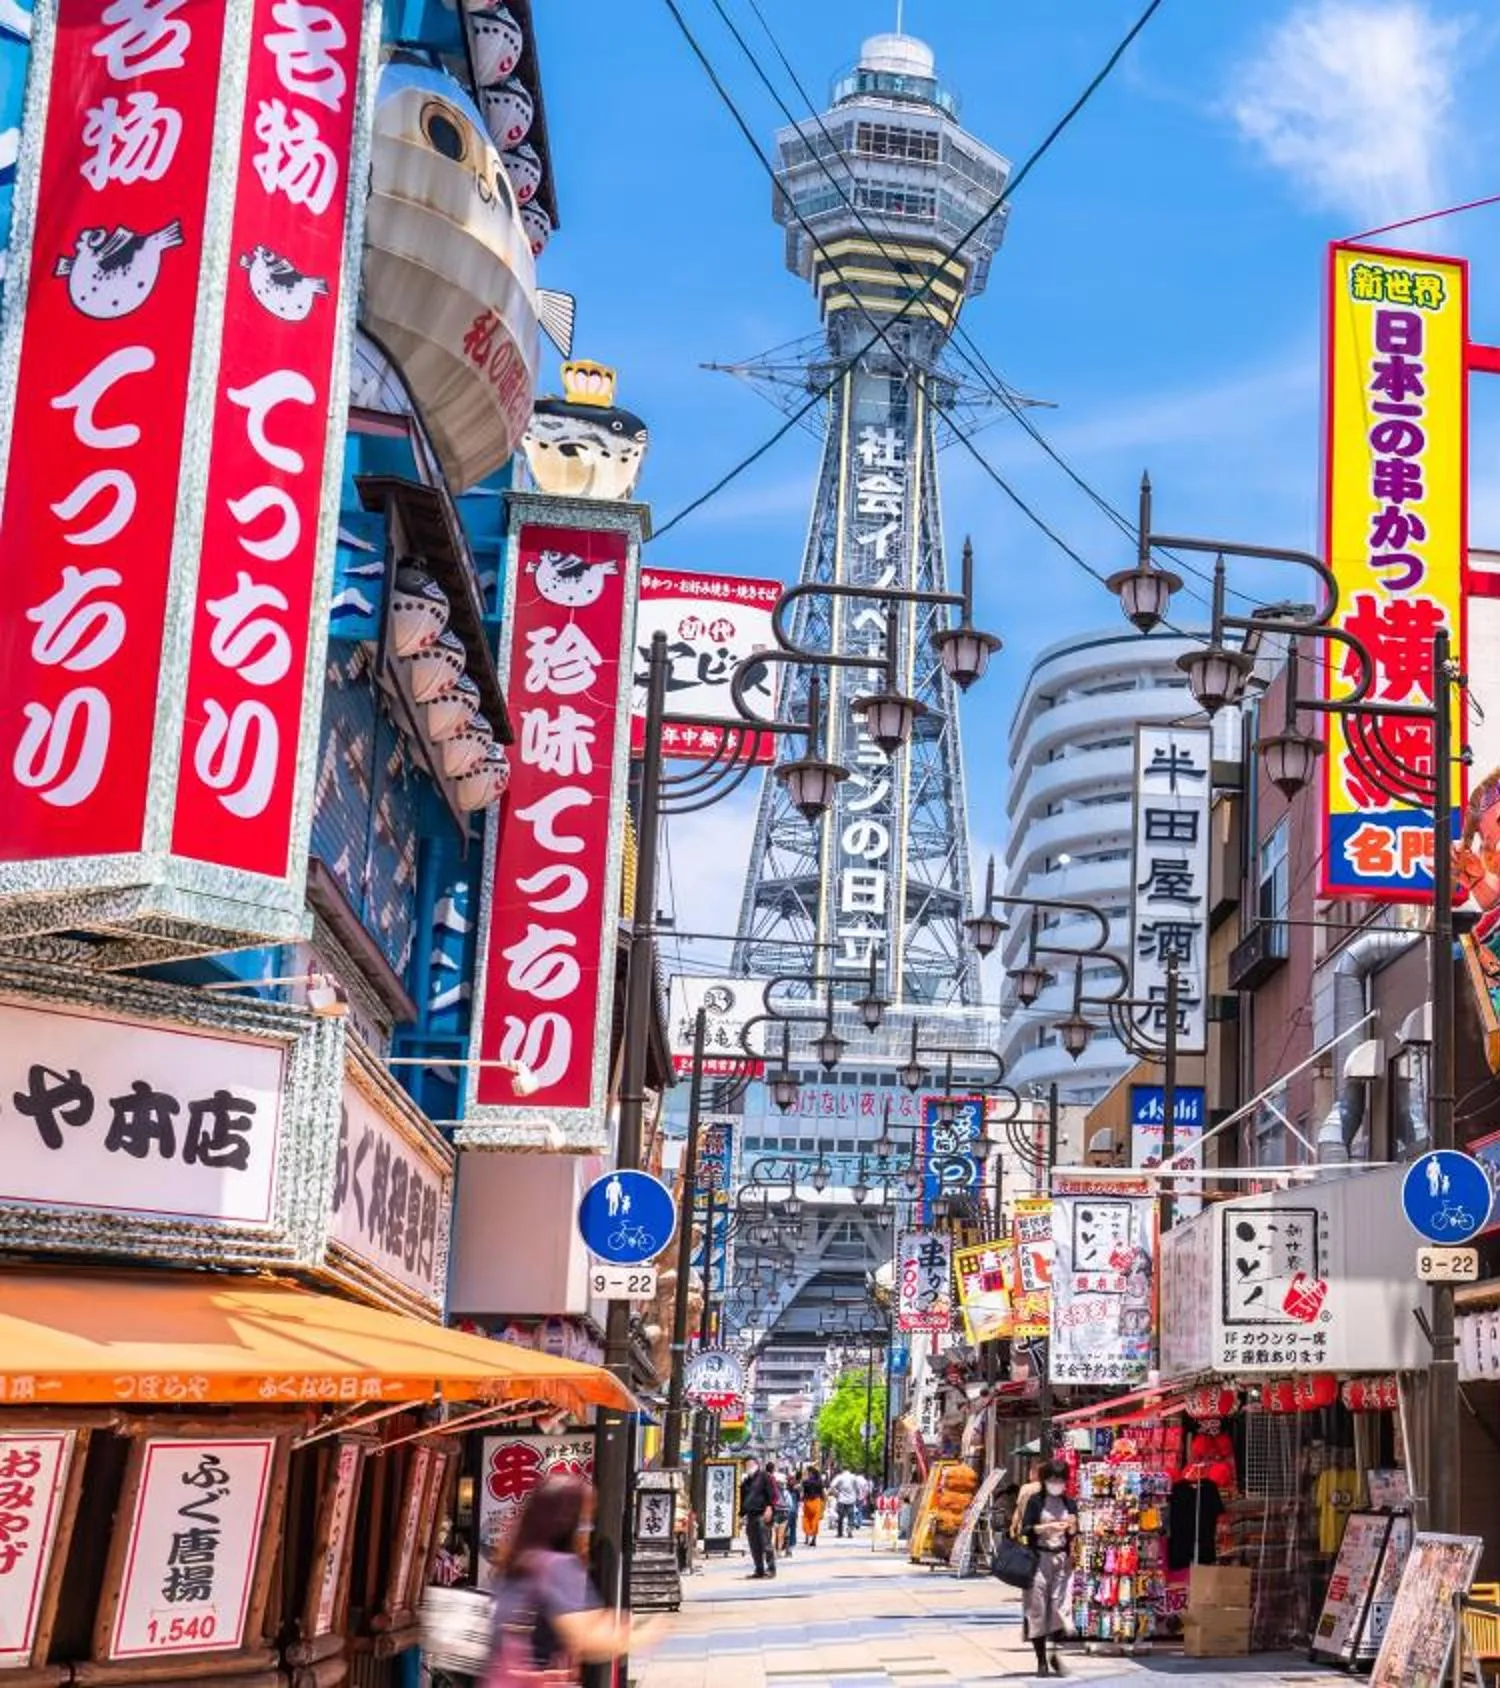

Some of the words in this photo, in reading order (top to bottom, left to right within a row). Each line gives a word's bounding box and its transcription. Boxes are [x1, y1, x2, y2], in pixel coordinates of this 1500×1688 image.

[1351, 263, 1446, 310] 新世界
[1368, 310, 1426, 590] 日本一の串かつ
[12, 345, 156, 807] てっちり
[194, 369, 316, 818] てっちり
[1137, 1096, 1198, 1121] Ashi
[147, 1615, 217, 1644] 1,540
